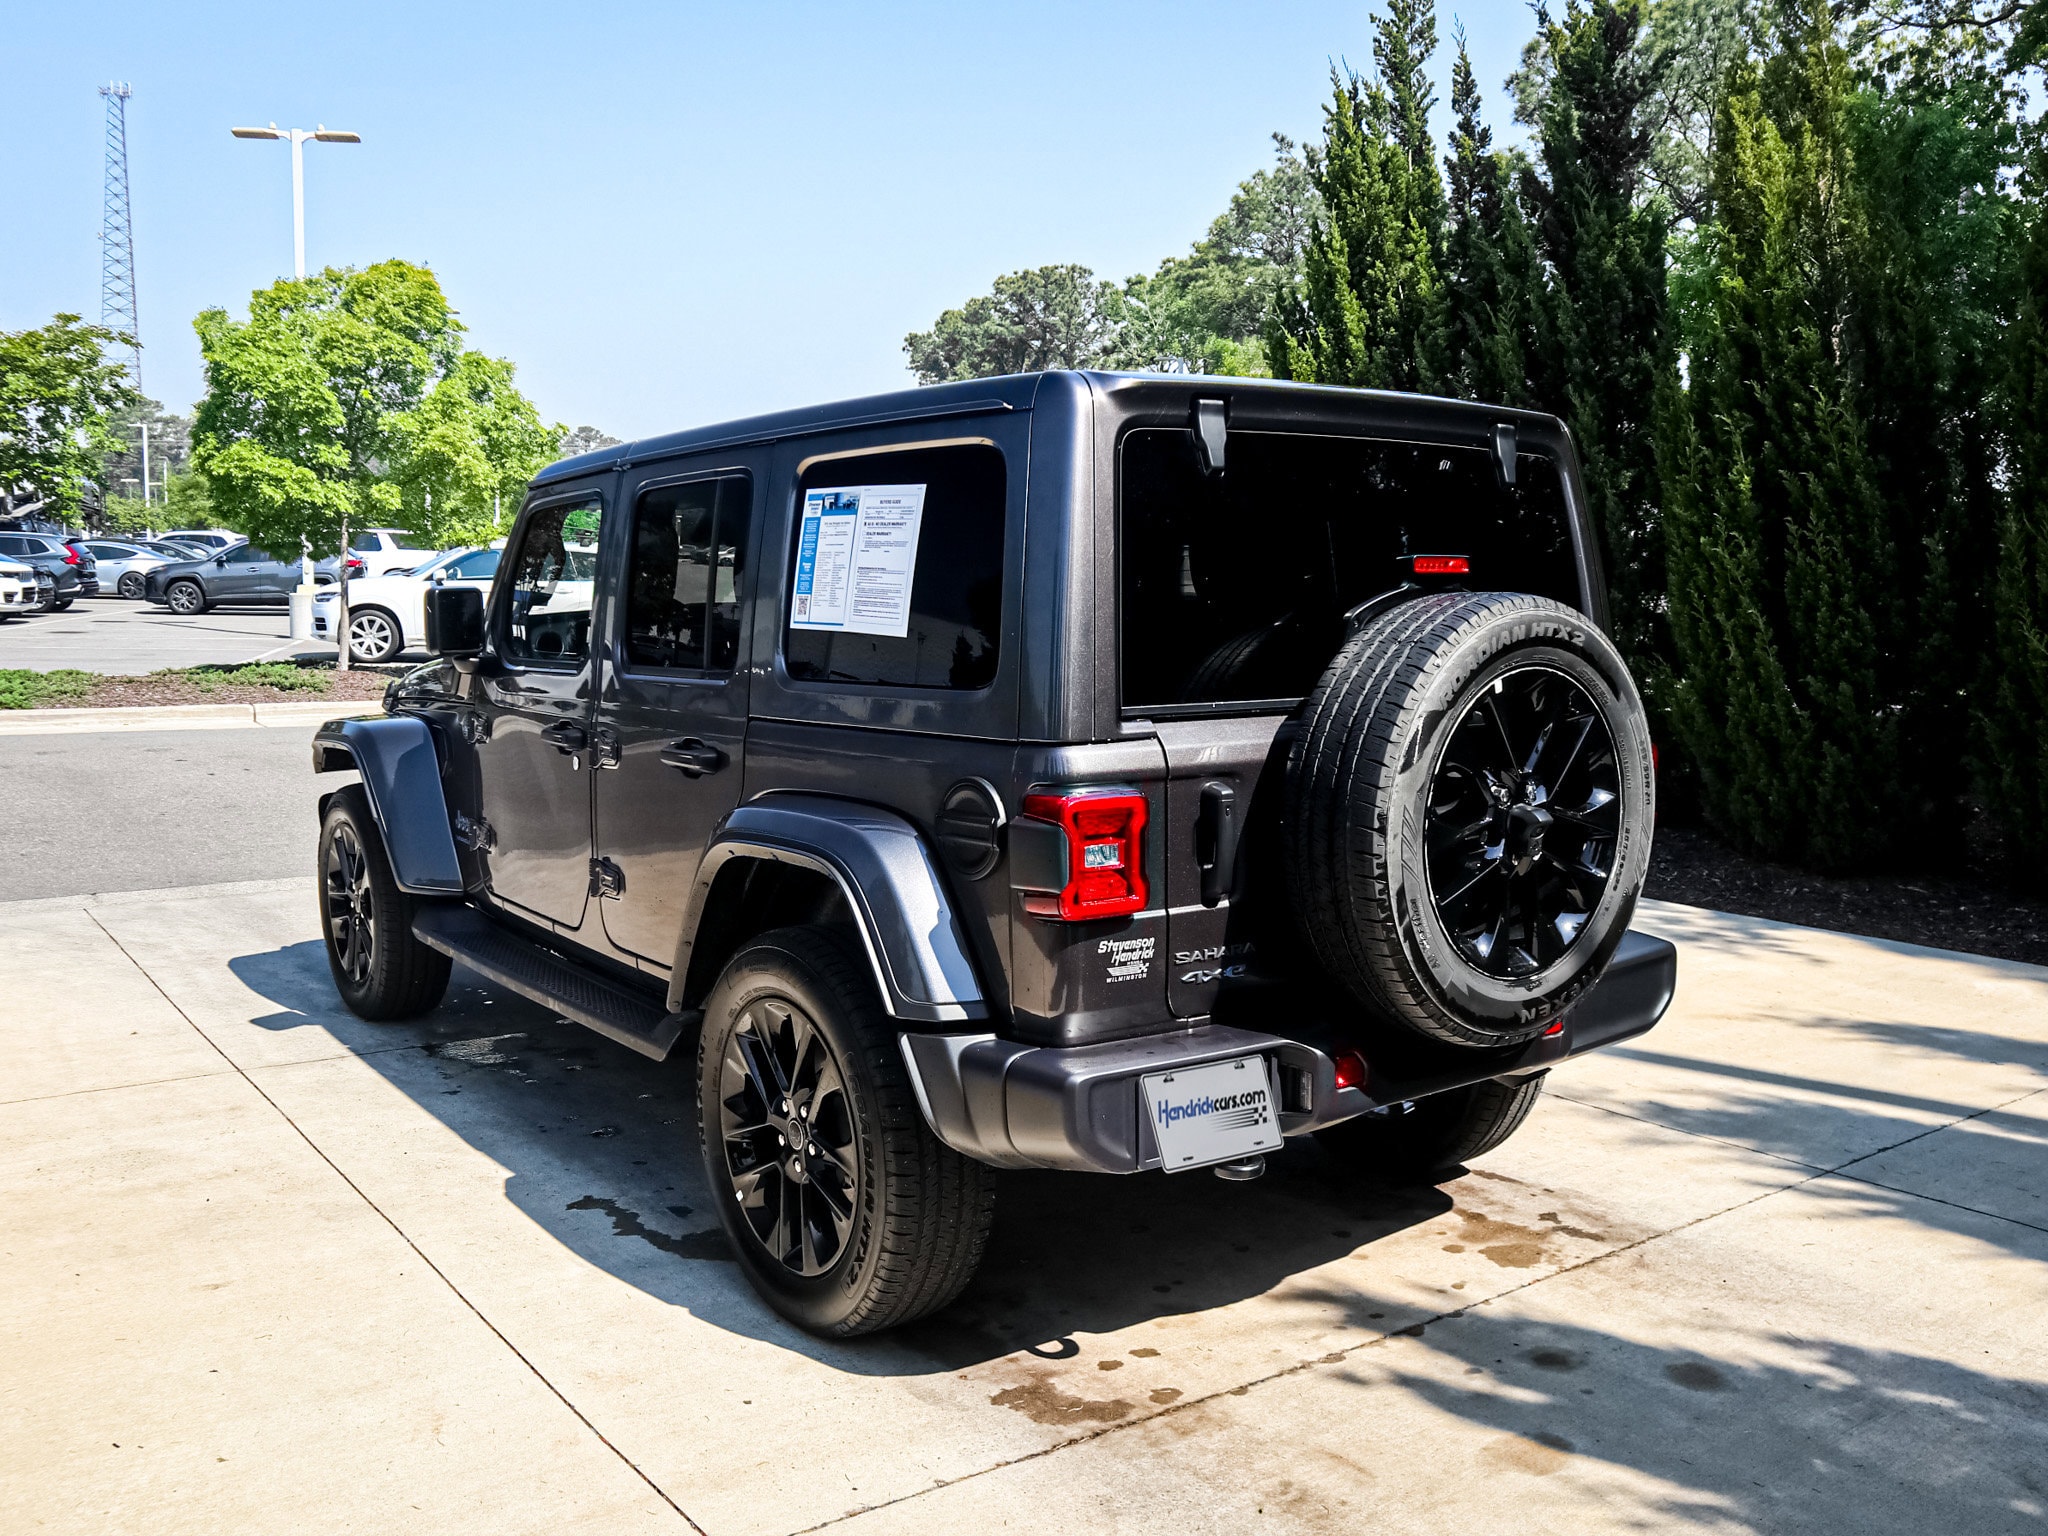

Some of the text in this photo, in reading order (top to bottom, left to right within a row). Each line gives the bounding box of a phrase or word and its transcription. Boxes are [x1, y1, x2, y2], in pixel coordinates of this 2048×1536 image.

[1440, 624, 1526, 712] ROADIAN
[1097, 937, 1155, 953] Stevenson
[1110, 947, 1155, 966] Hendrick
[1106, 973, 1148, 984] WILMINGTON
[1158, 1089, 1266, 1128] Hendrickcars.com
